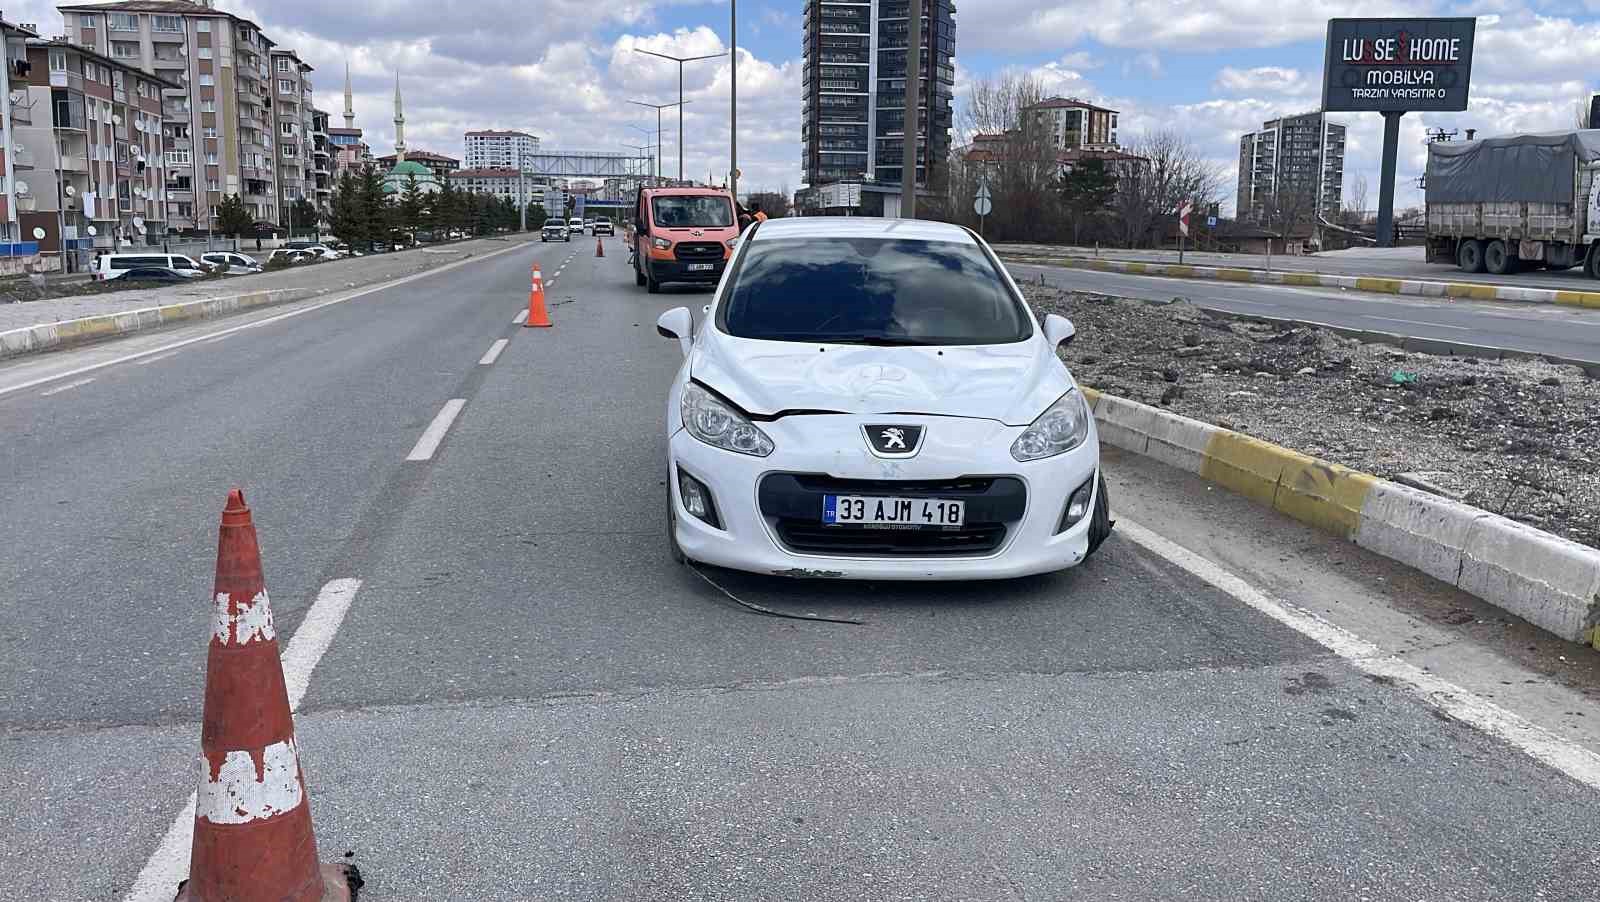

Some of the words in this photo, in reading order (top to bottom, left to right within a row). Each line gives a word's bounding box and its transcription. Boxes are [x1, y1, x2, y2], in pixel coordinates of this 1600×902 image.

[1409, 38, 1461, 61] HOME
[840, 499, 865, 520] 33
[874, 500, 912, 521] AJM
[922, 502, 960, 523] 418
